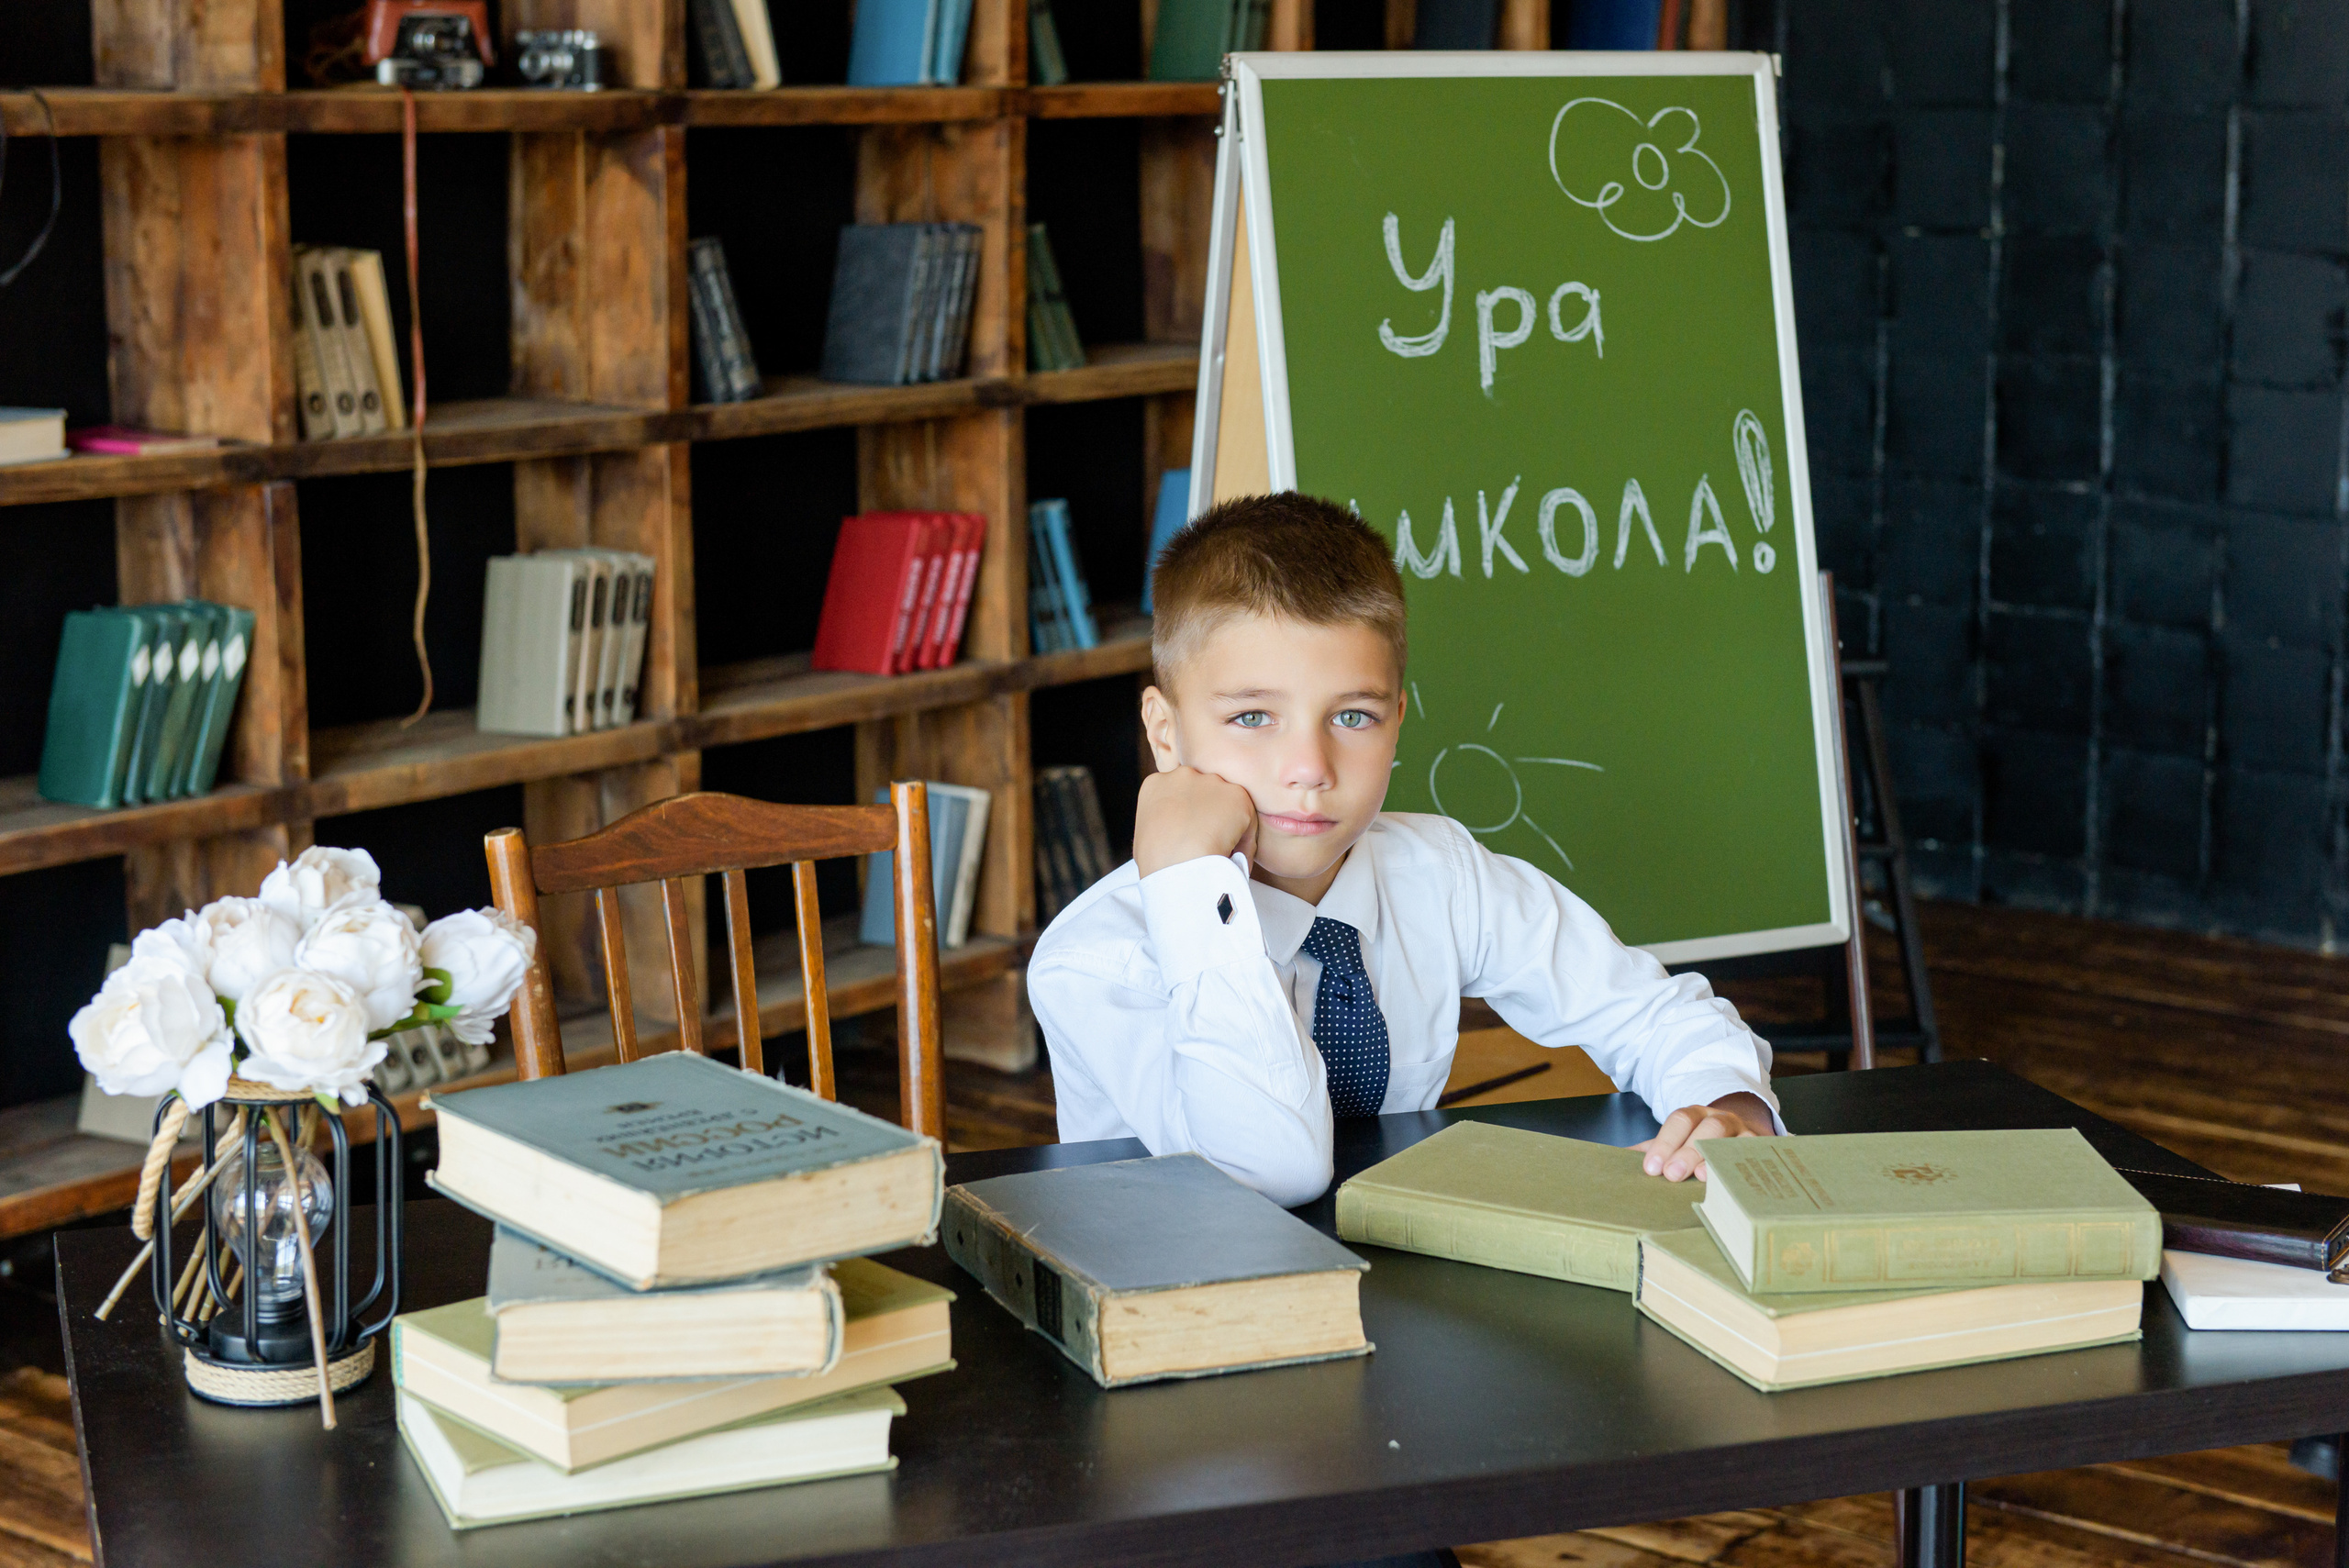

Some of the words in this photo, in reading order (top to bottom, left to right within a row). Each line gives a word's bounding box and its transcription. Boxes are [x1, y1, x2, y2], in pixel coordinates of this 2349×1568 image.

[1378, 211, 1604, 395] Ура
[601, 1113, 805, 1159] РОССИИ
[631, 1125, 840, 1172] ИСТОРИЯ
